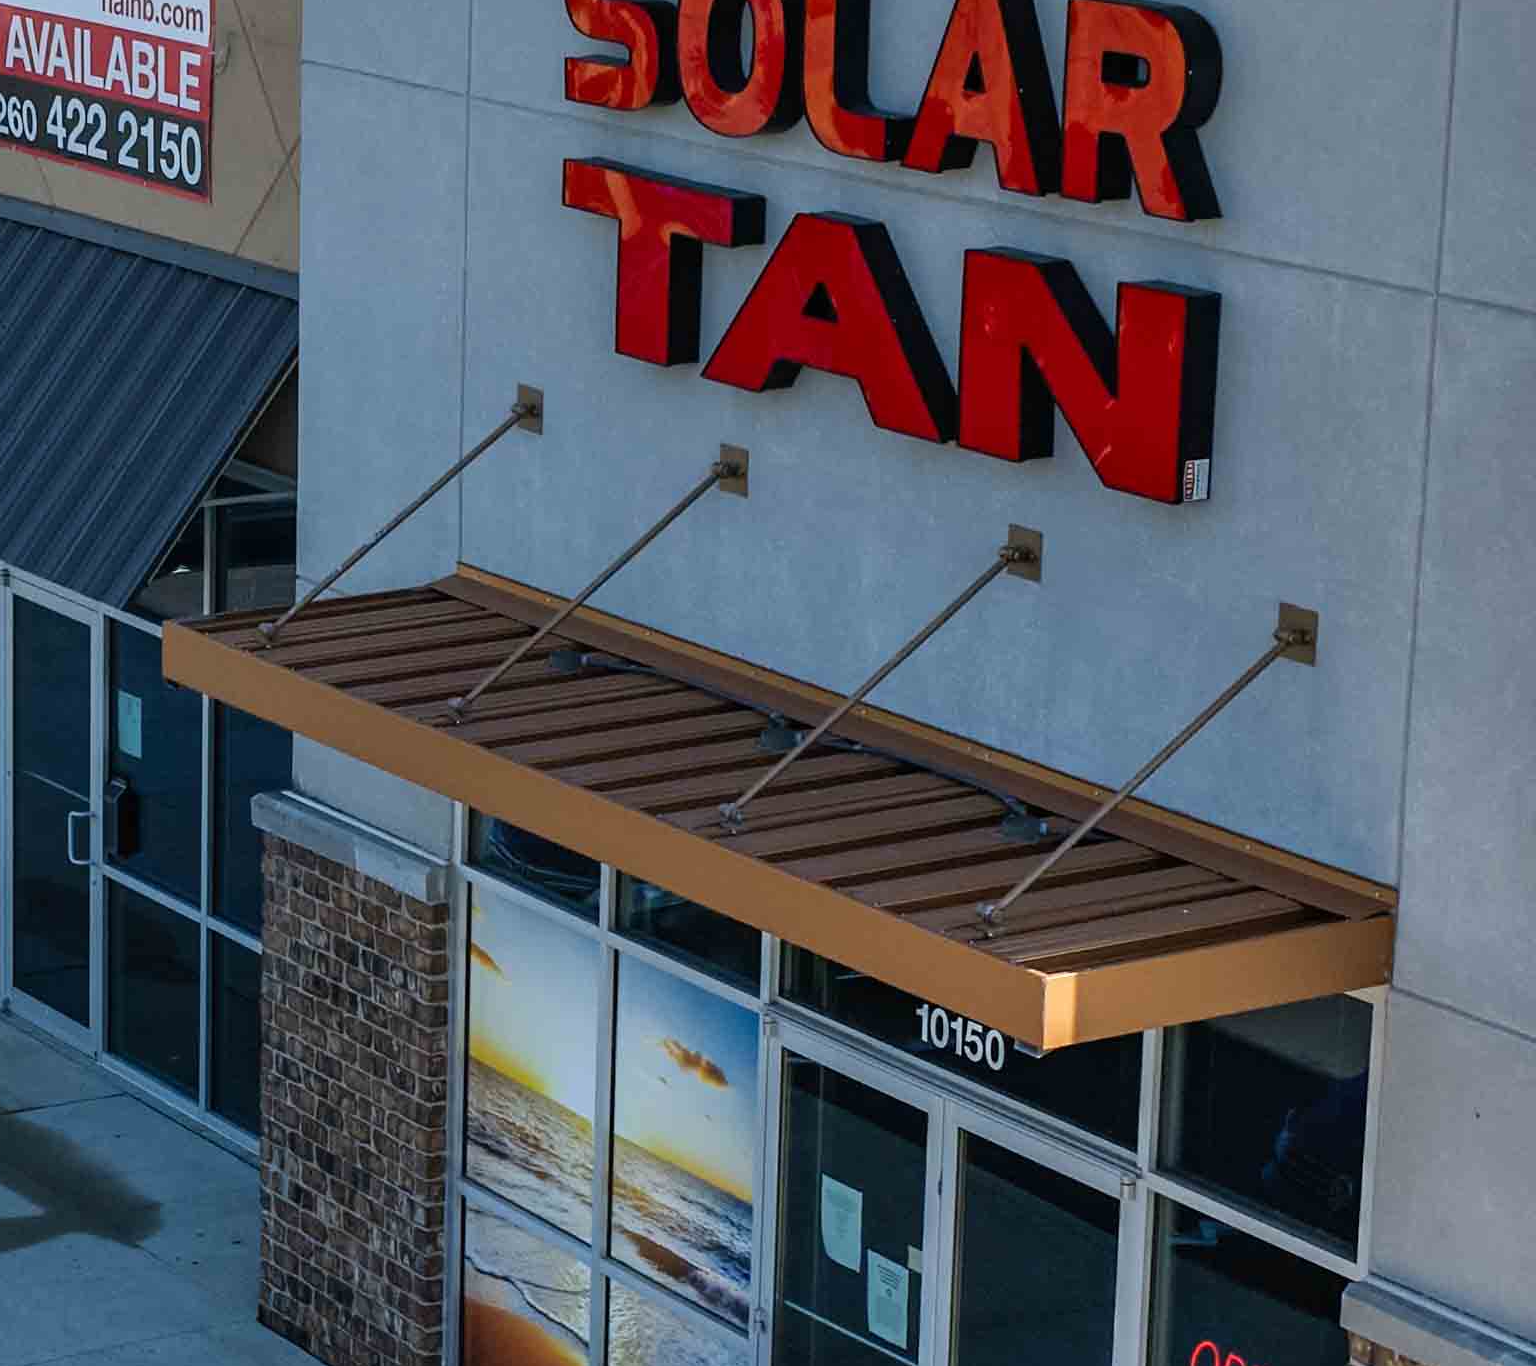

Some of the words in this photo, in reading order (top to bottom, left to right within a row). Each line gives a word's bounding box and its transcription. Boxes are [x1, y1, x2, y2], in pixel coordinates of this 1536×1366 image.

[5, 14, 202, 113] AVAILABLE
[47, 95, 109, 161] 422
[117, 110, 203, 186] 2150
[562, 157, 1223, 505] TAN
[915, 1003, 1006, 1072] 10150
